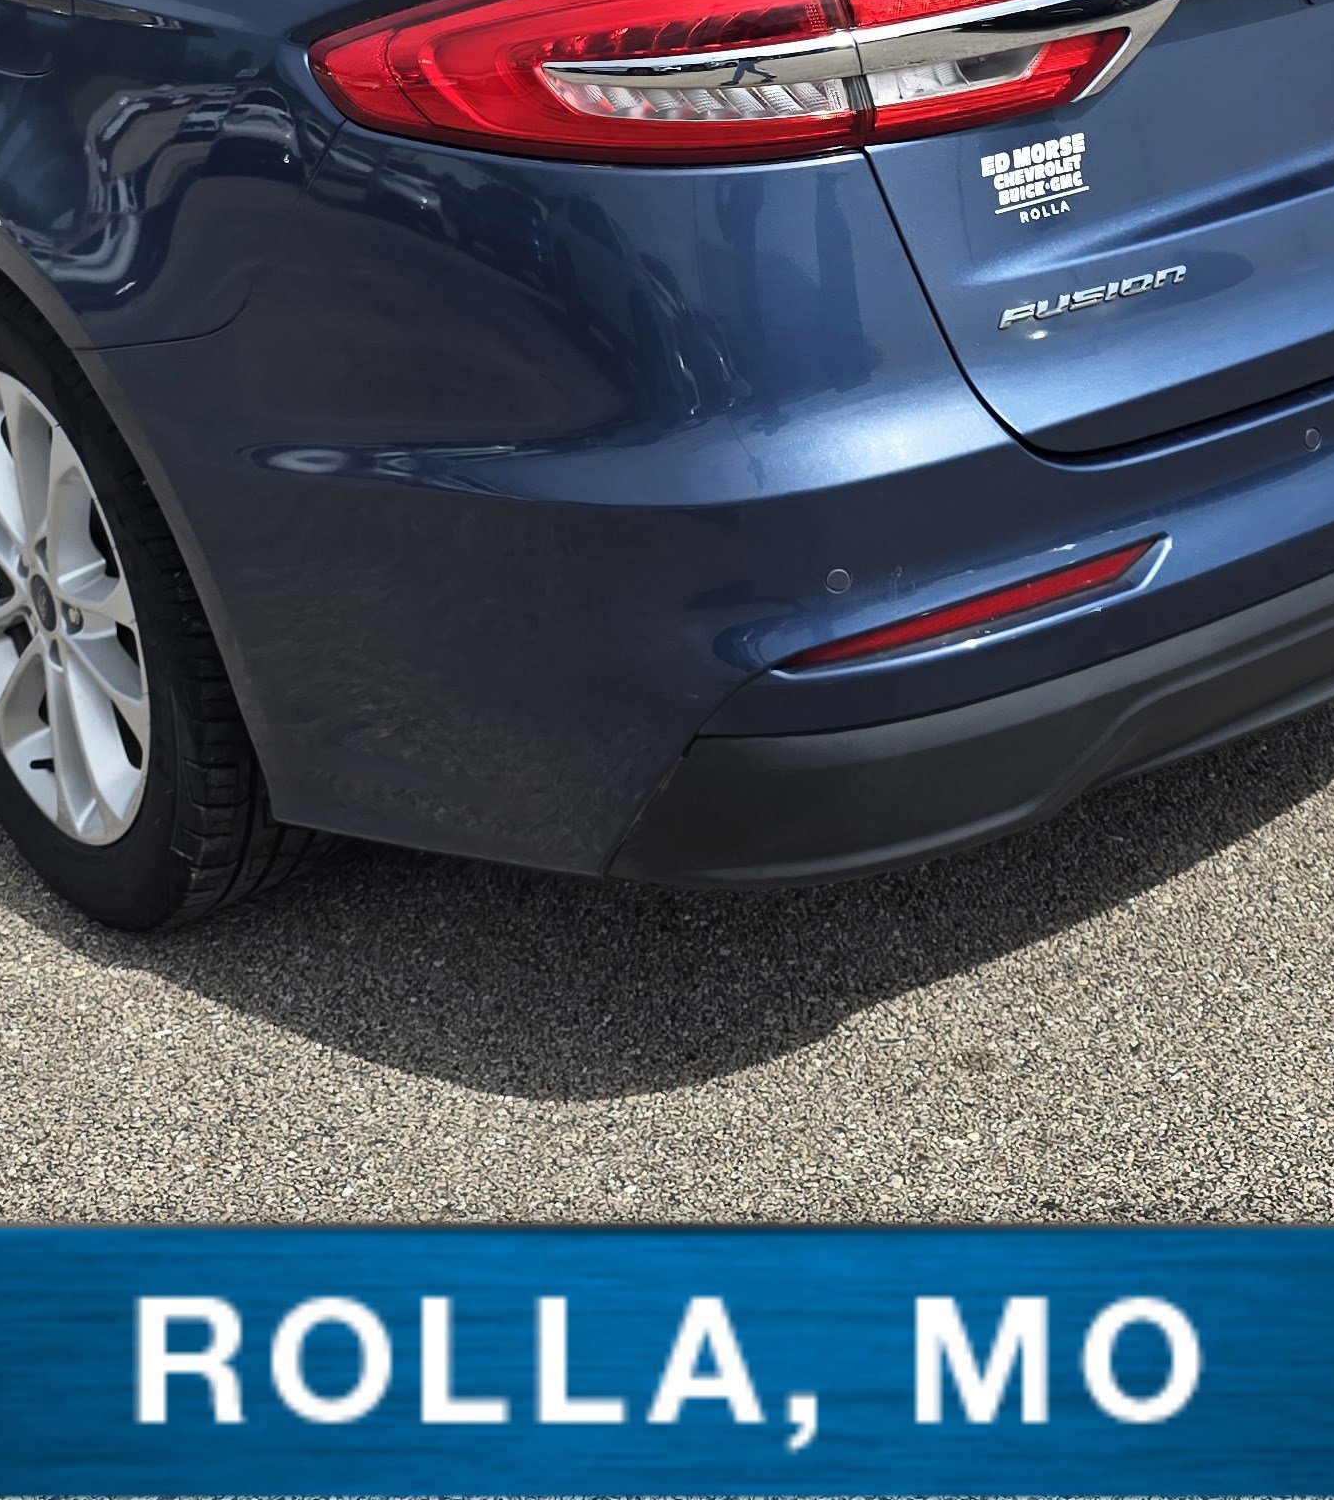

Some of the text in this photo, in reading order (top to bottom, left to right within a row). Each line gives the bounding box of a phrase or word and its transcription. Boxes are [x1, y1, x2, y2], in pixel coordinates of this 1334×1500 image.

[980, 132, 1086, 177] ED MORSE
[994, 154, 1082, 190] CHEVROLET
[1019, 200, 1071, 224] ROLLA
[997, 264, 1187, 330] FUSION
